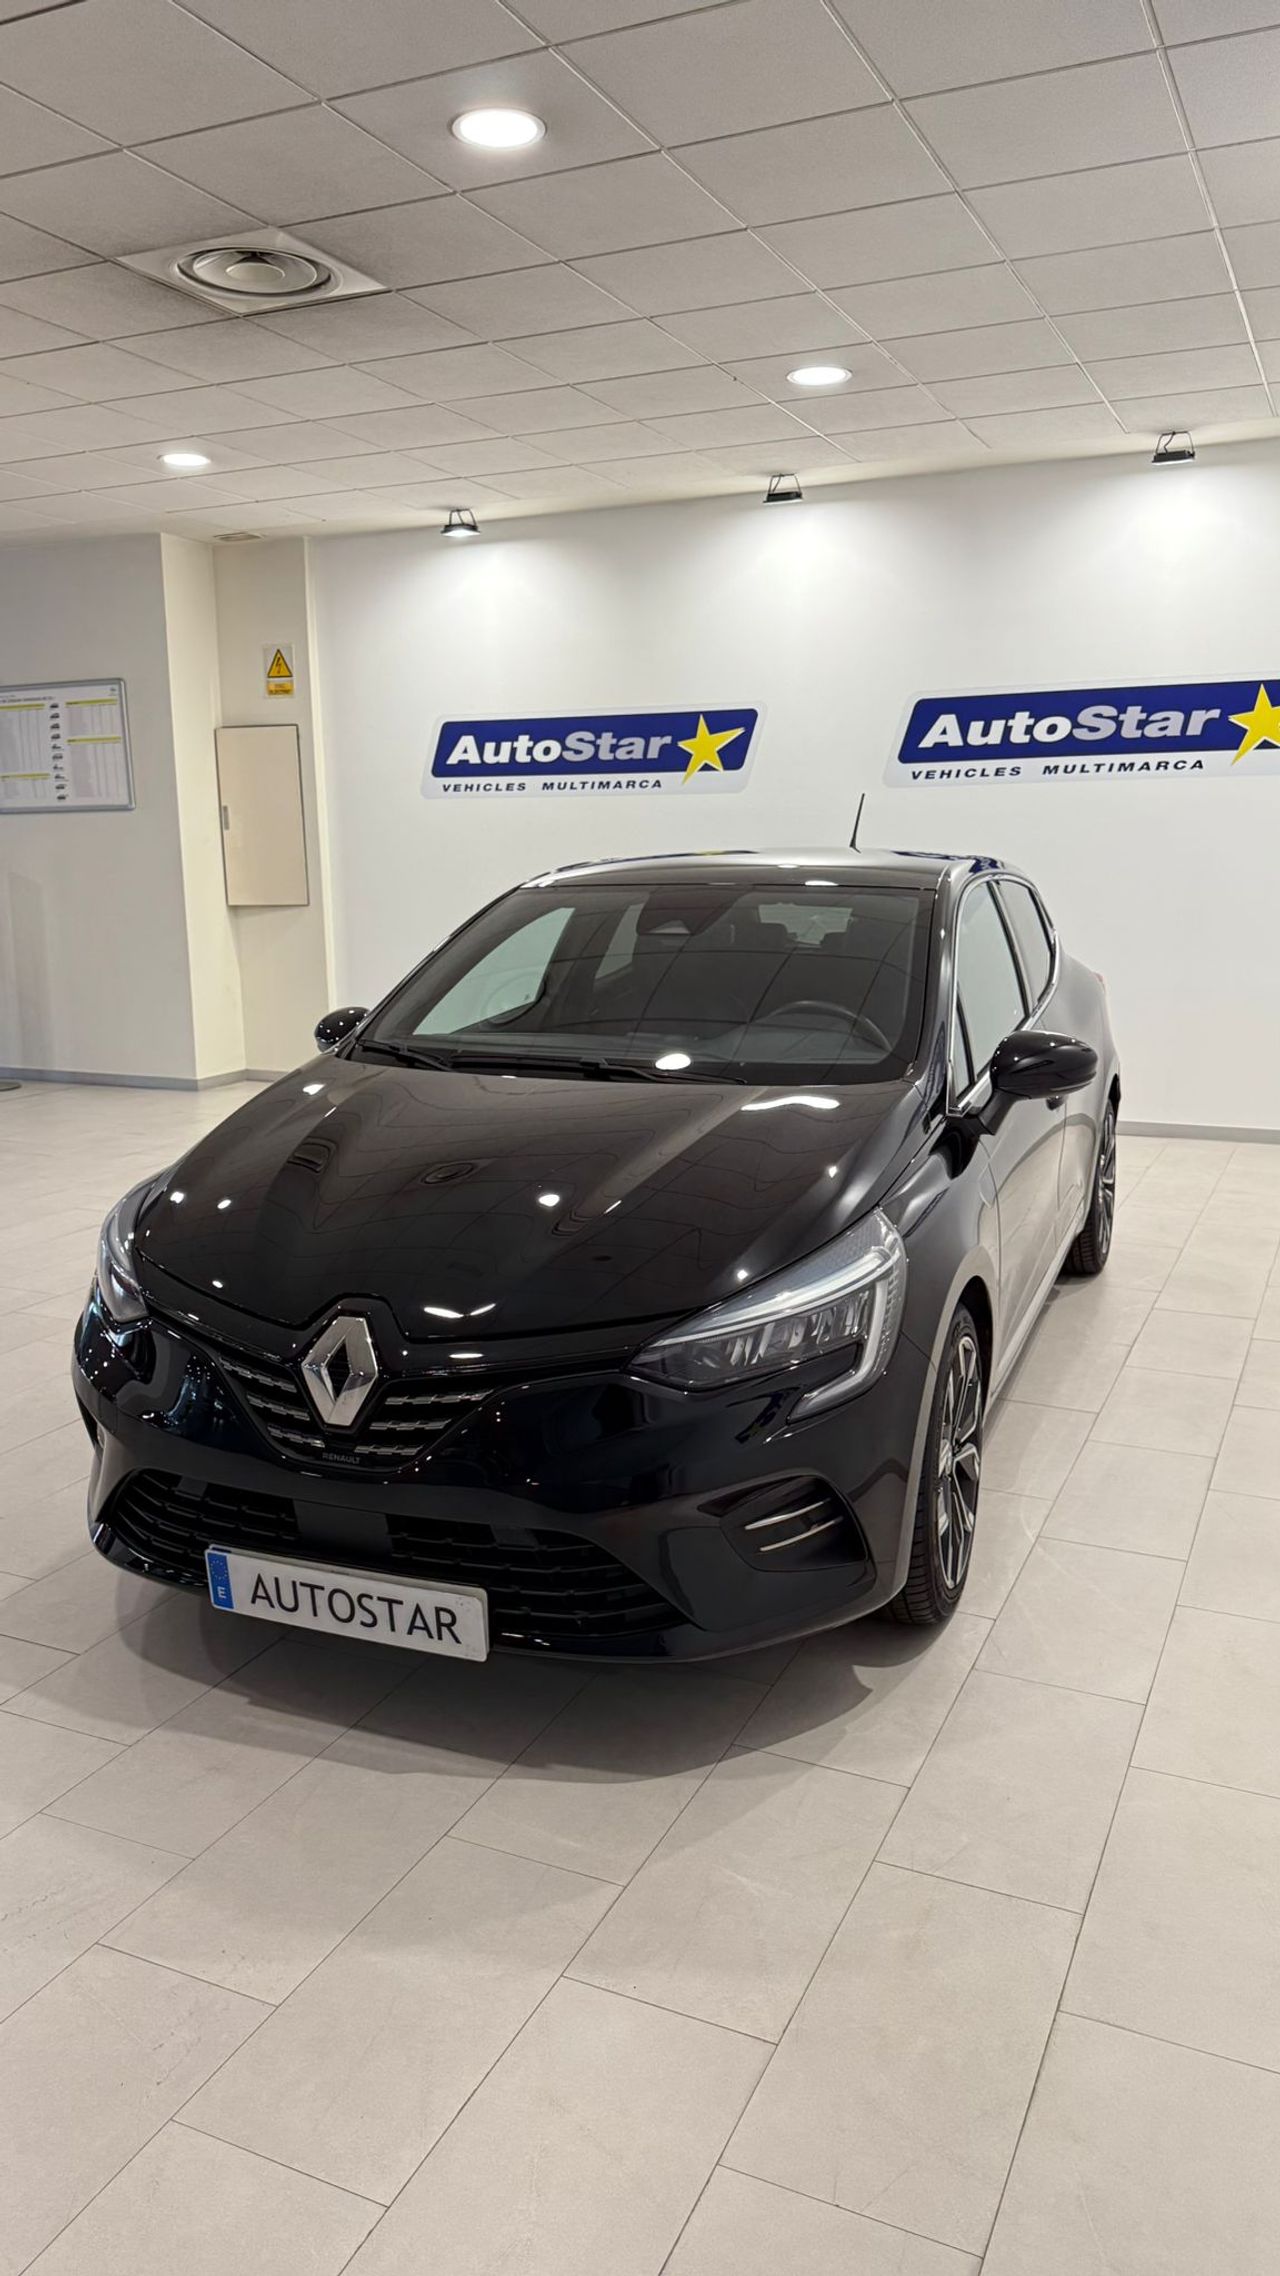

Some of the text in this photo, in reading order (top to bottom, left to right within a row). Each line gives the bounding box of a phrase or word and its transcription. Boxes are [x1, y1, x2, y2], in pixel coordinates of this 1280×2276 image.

[917, 704, 1221, 748] AutoStar
[446, 731, 672, 765] AutoStar
[911, 759, 1204, 781] VEHICLES MULTIMARCA
[442, 779, 662, 793] VEHICLES MULTIMARCA
[322, 1452, 360, 1465] RENAULT
[250, 1573, 462, 1645] AUTOSTAR
